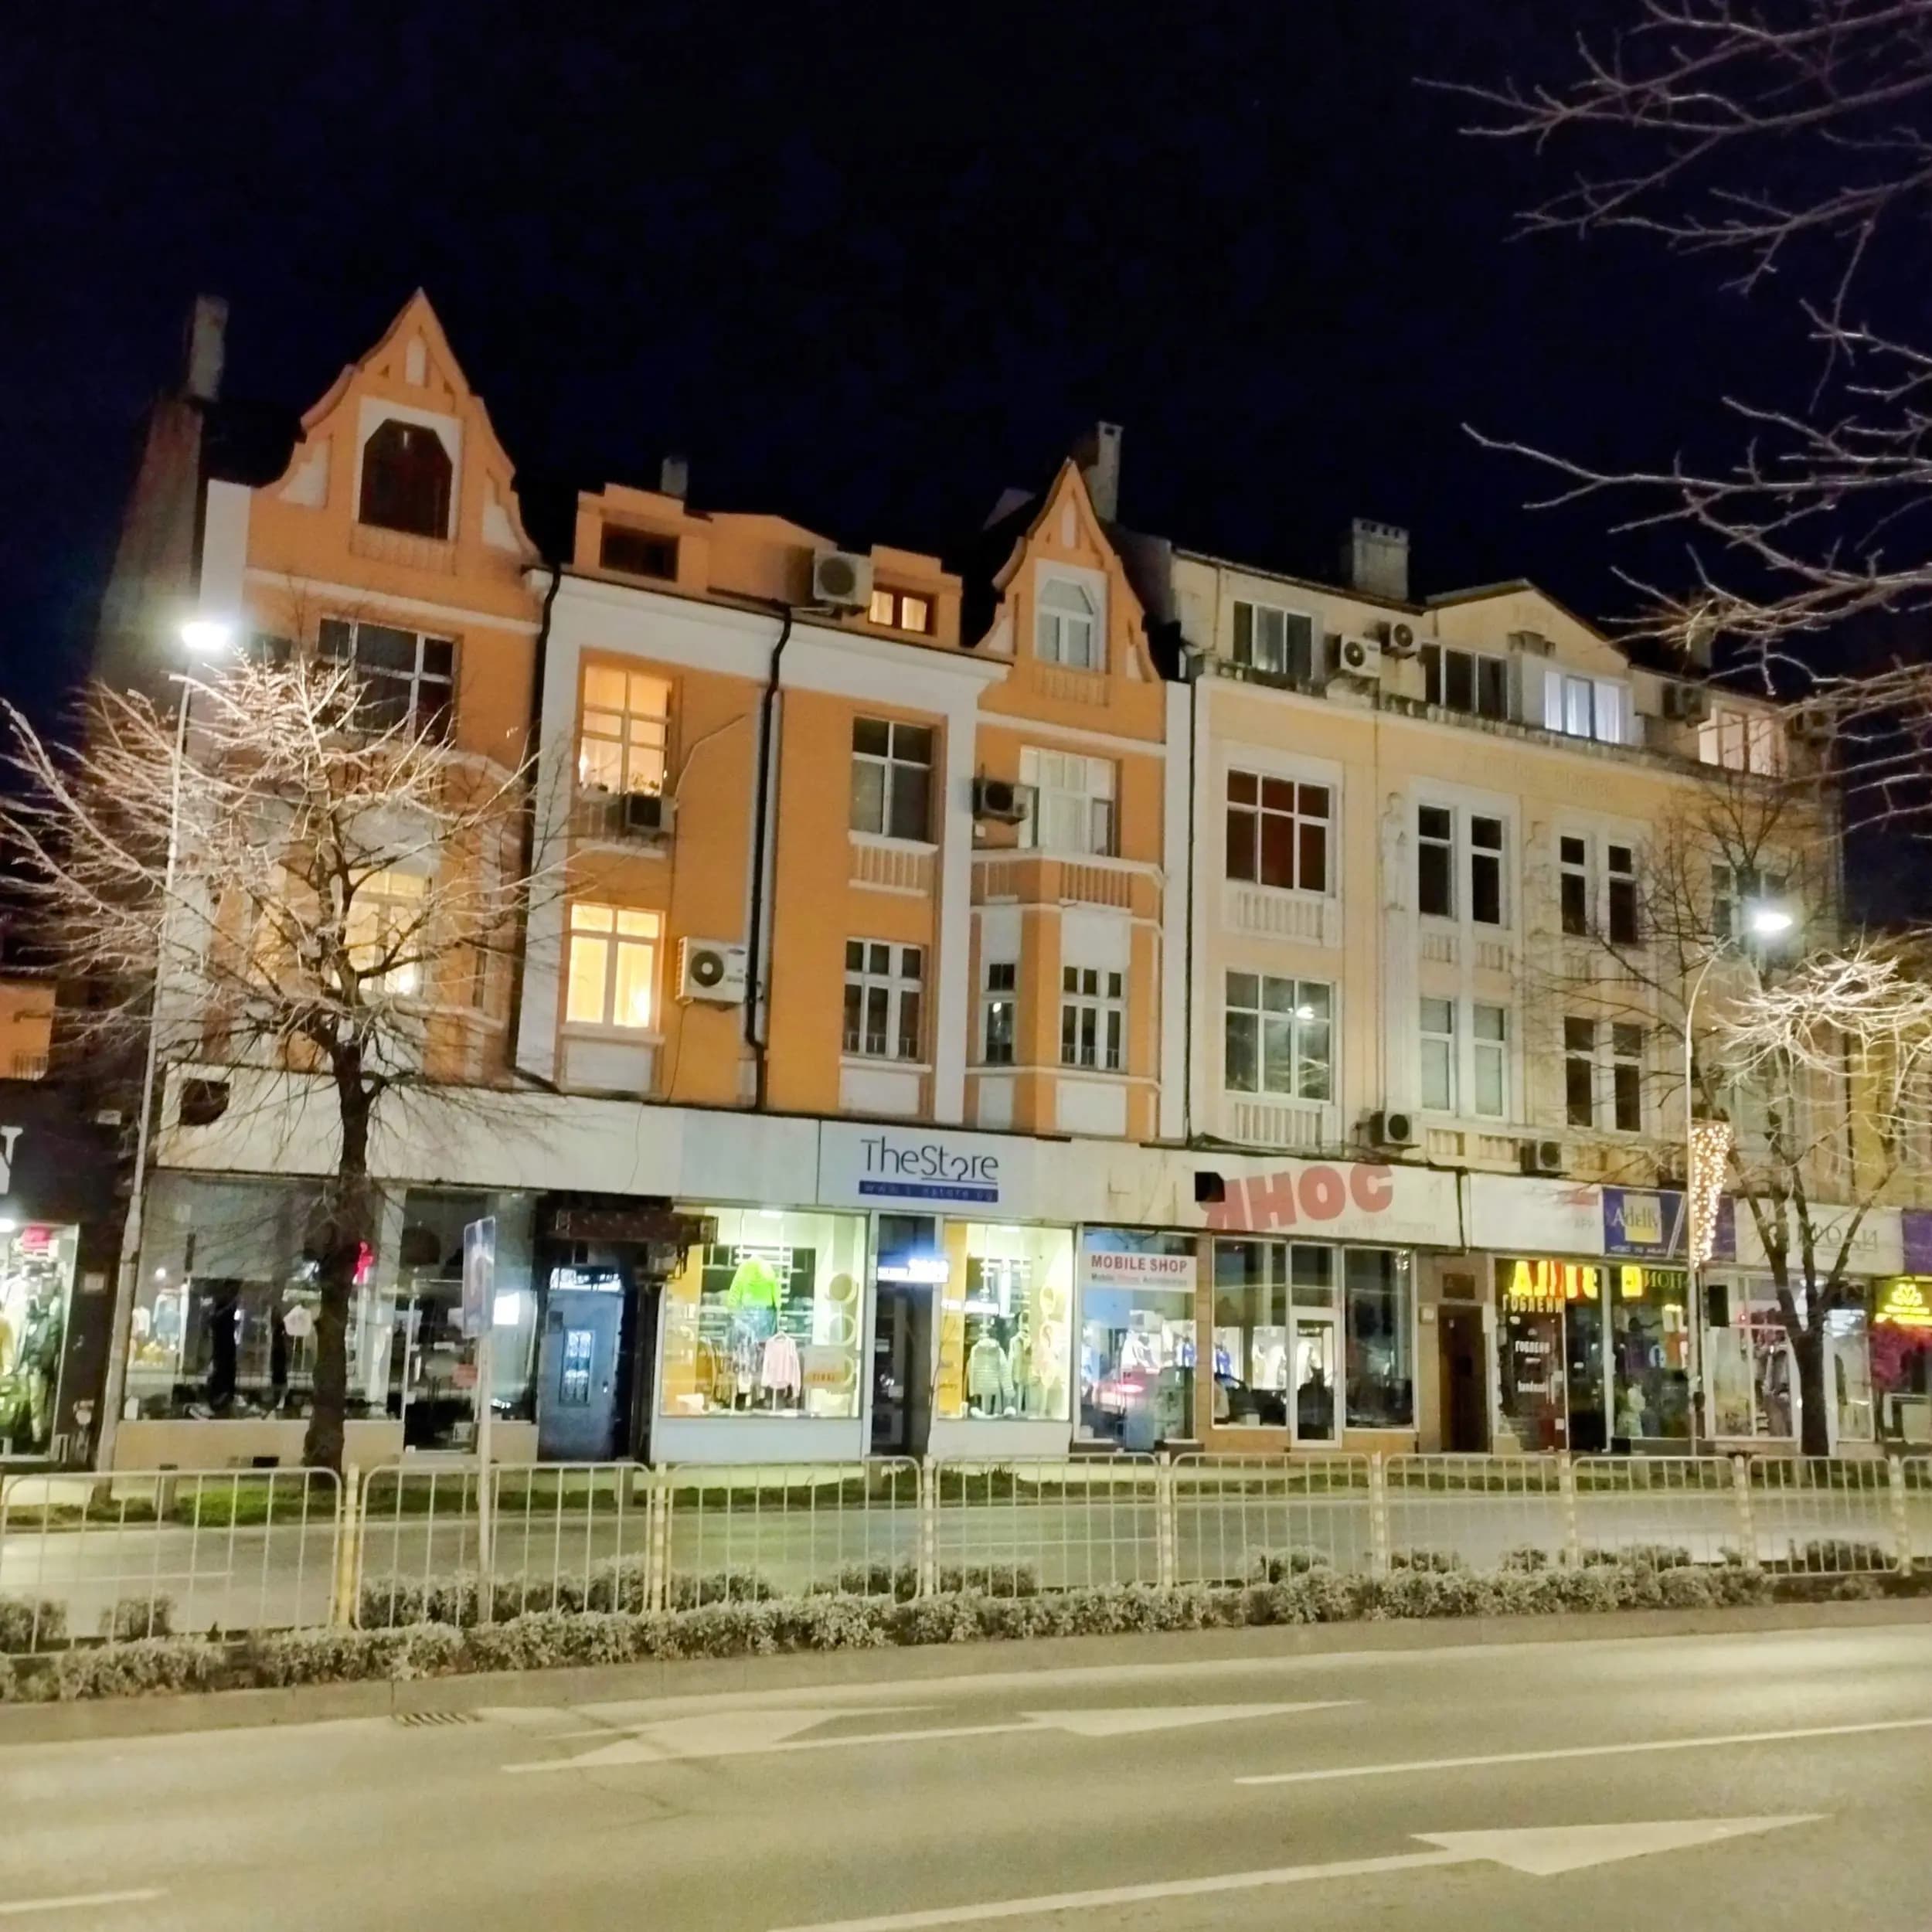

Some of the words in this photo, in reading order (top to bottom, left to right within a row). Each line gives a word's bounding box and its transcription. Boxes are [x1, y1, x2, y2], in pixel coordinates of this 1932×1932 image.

[860, 1135, 999, 1182] TheStore
[1091, 1254, 1146, 1270] MOBILE
[1149, 1258, 1188, 1273] SHOP
